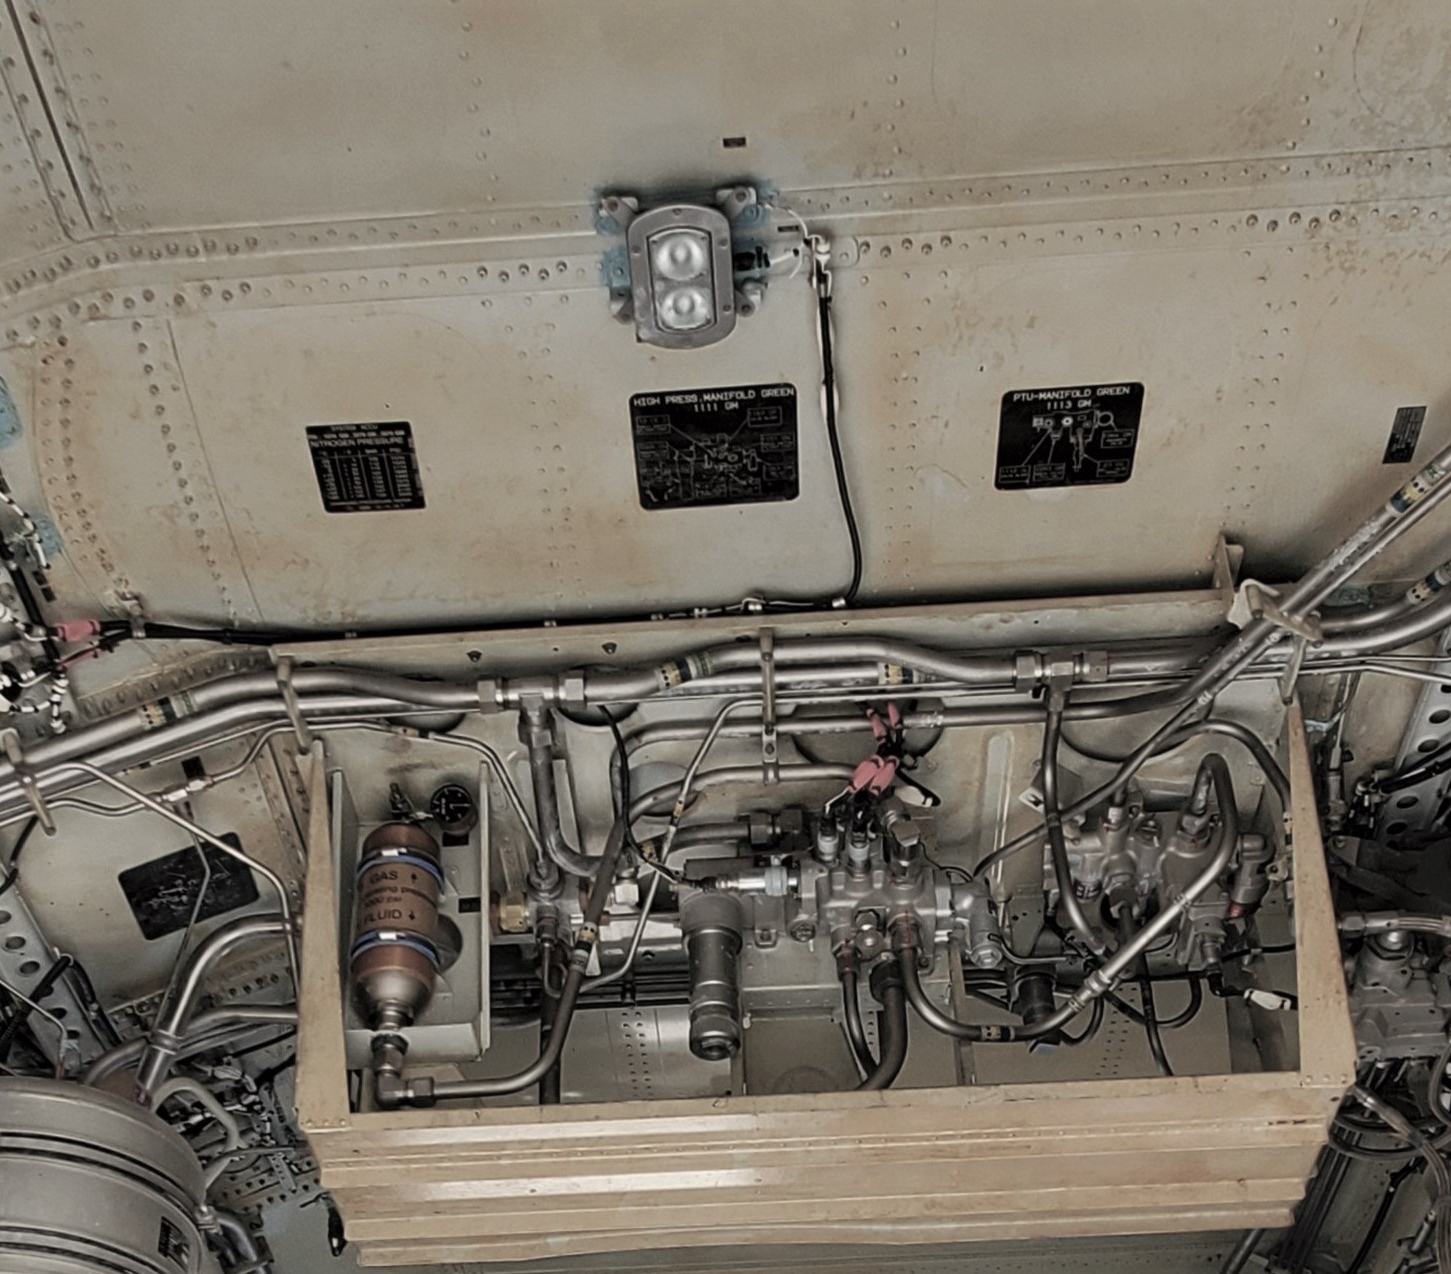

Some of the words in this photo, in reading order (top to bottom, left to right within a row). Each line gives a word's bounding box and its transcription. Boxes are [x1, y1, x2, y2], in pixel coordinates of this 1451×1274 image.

[633, 397, 661, 407] HIGH
[760, 387, 795, 398] GREEN
[1013, 389, 1091, 402] PTU-MANIFOLD
[1096, 386, 1131, 396] GREEN
[694, 403, 718, 412] 1111
[1047, 400, 1072, 410] 1113
[1078, 400, 1092, 408] GM
[310, 438, 356, 448] NITROGEN
[356, 436, 405, 446] PRESSURE
[370, 870, 398, 884] GAS
[364, 908, 403, 924] FLUID
